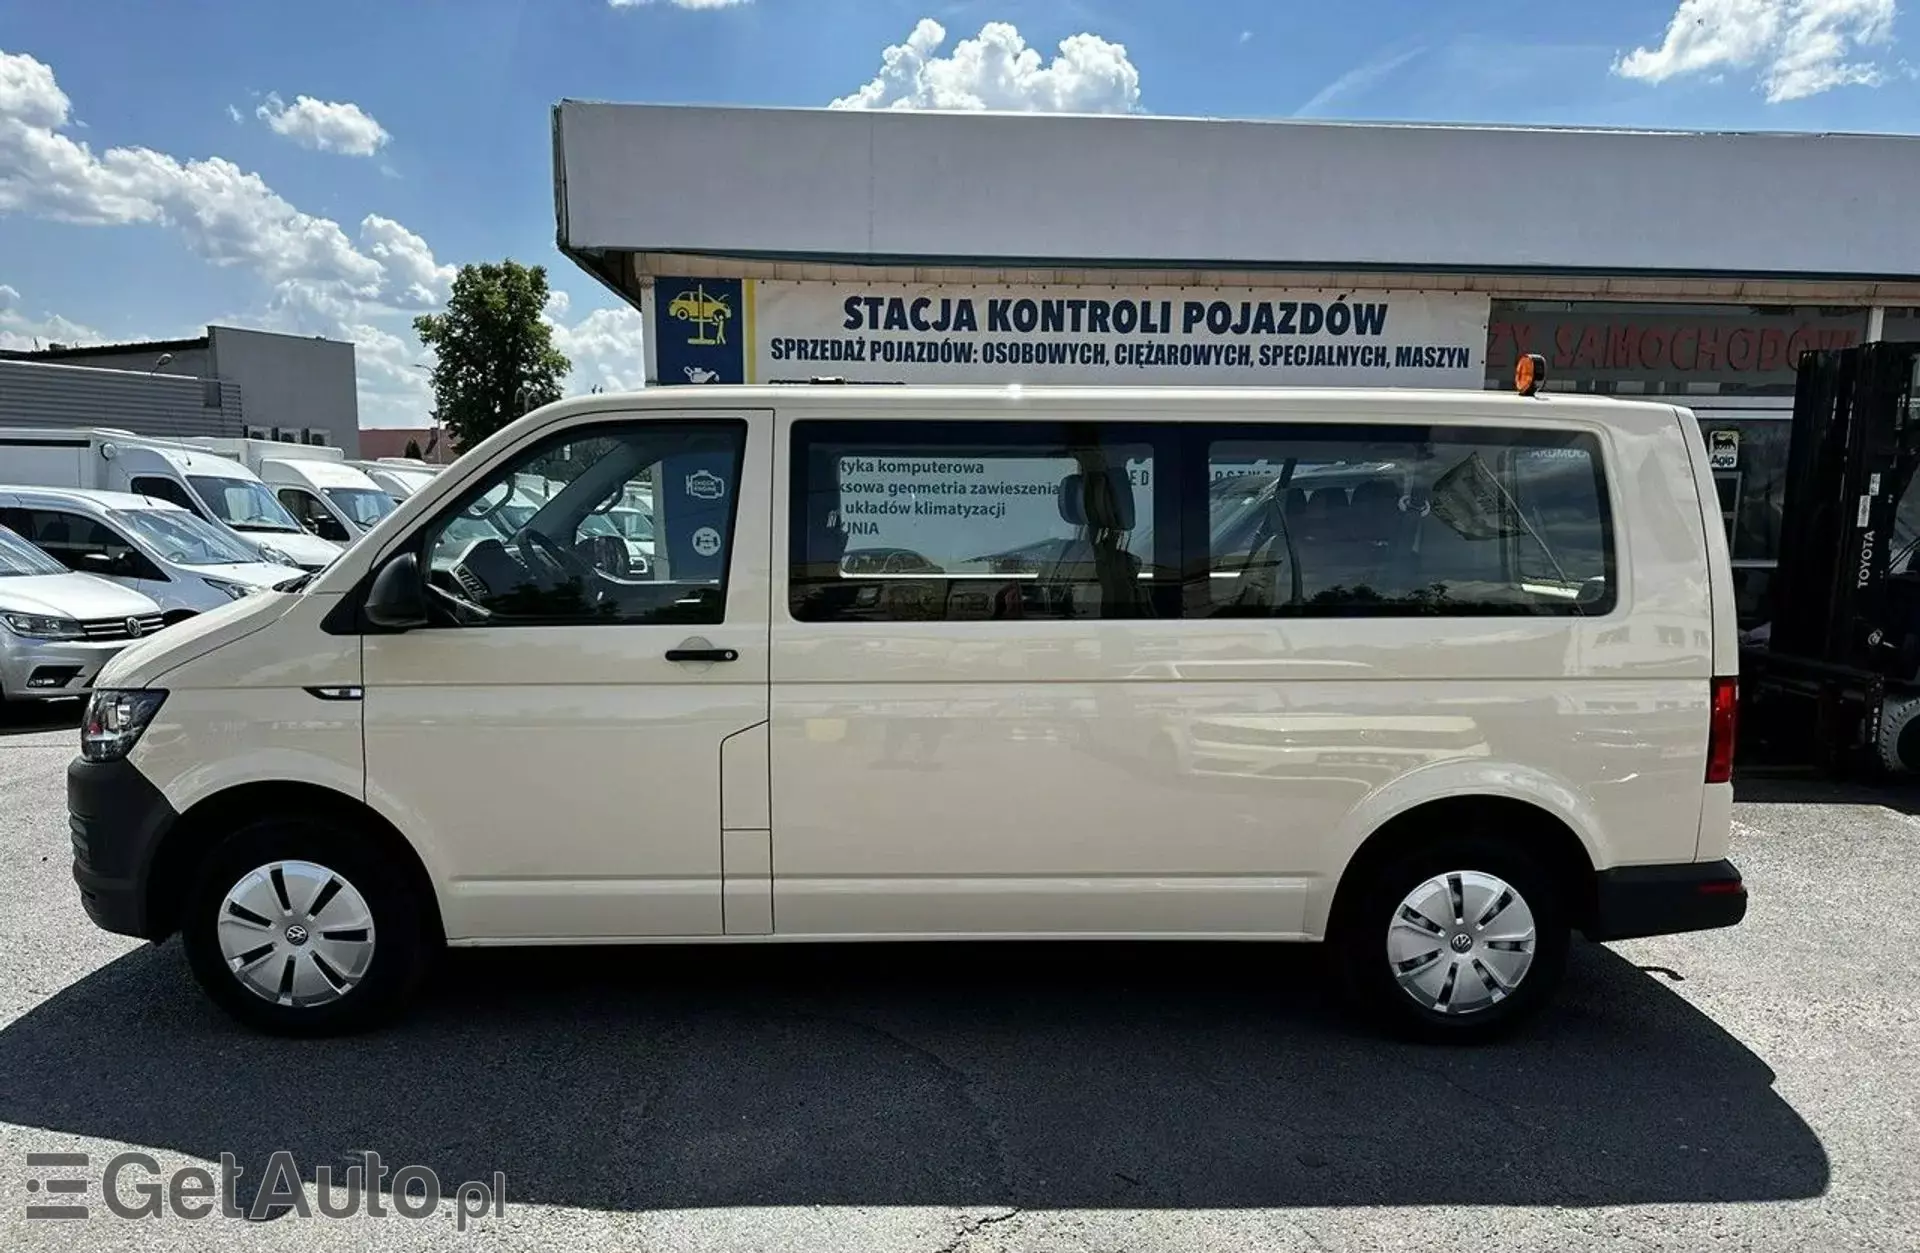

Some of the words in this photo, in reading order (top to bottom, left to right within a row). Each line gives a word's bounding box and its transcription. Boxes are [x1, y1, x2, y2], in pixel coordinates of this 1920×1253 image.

[843, 296, 978, 332] STACJA
[988, 298, 1171, 334] KONTROLI
[1183, 294, 1388, 336] POJAZDÓW
[771, 336, 866, 362] SPRZEDAŻ
[870, 338, 978, 364] POJAZDÓW:
[983, 342, 1110, 367] OSOBOWYCH,
[1114, 340, 1254, 369] CIĘŻAROWYCH,
[1258, 344, 1390, 369] SPECJALNYCH,
[1395, 346, 1470, 369] MASZYN
[840, 459, 875, 476] tyka
[878, 459, 985, 476] komputerowa
[1711, 454, 1736, 469] Agip
[888, 480, 967, 497] geometria
[969, 481, 1060, 496] zawieszenia
[845, 500, 911, 516] układów
[914, 501, 1006, 519] klimatyzacji
[1857, 530, 1876, 589] TOYOTA
